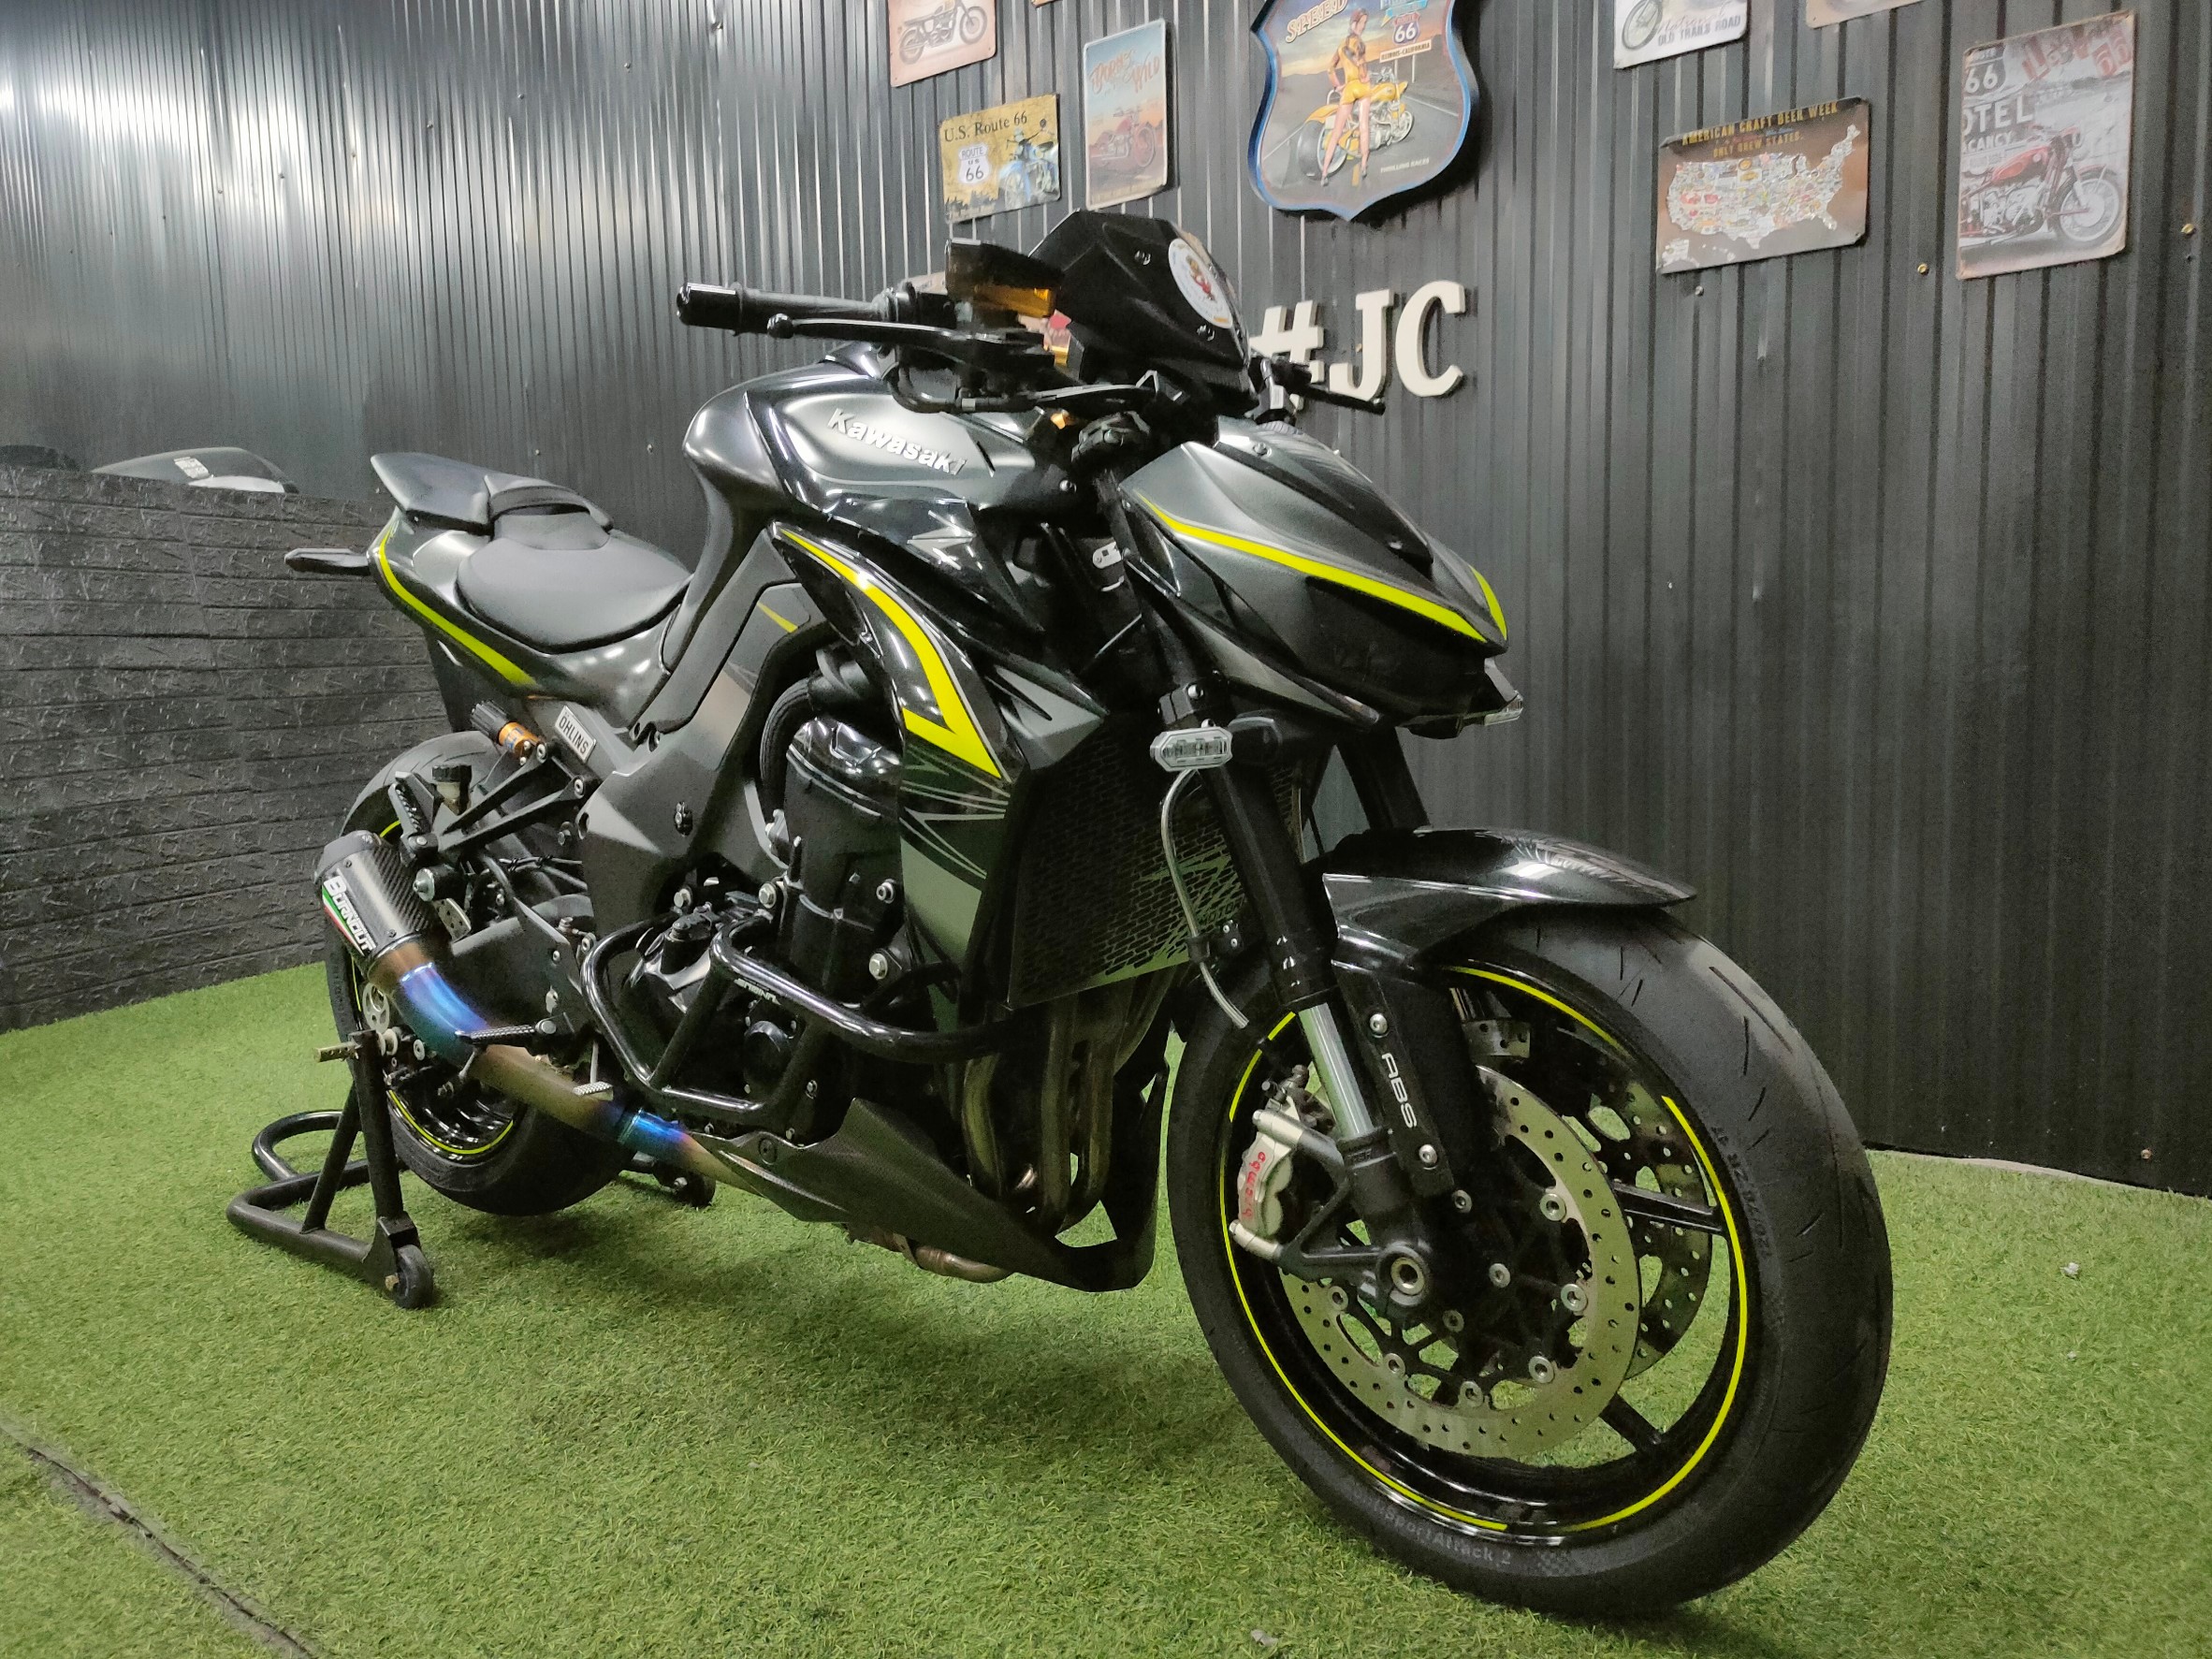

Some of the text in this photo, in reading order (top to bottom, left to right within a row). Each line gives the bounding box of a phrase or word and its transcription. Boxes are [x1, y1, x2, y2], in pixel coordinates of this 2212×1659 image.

[1394, 22, 1417, 43] 66
[1966, 64, 1999, 93] 66
[944, 110, 1027, 142] U.S. Route 66
[1681, 101, 1838, 147] AMERICAN CRAFT BEER WEEK
[961, 147, 983, 159] ROUTE
[966, 165, 984, 182] 66
[1250, 281, 1467, 410] #JC
[826, 407, 967, 475] Kawasaki
[559, 711, 589, 754] ÖHLINS
[1382, 1053, 1417, 1128] ABS
[1242, 1151, 1266, 1219] brembo
